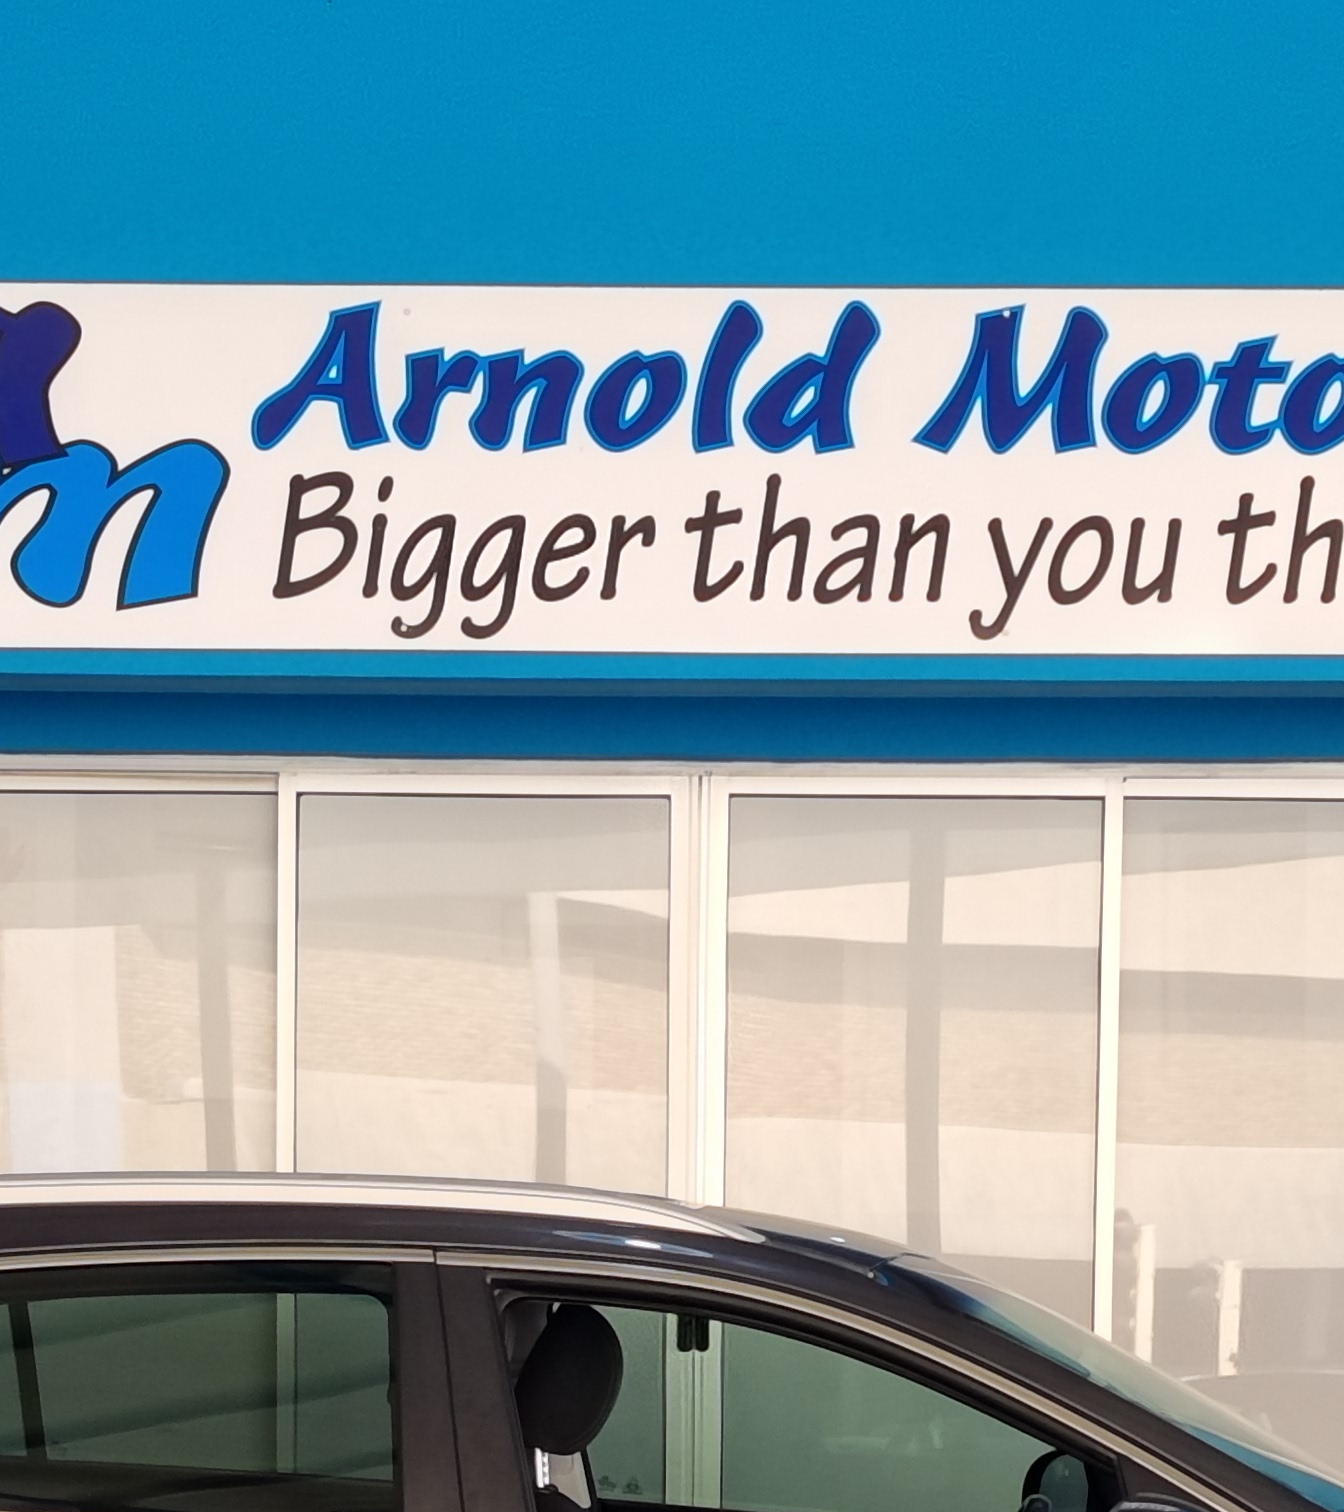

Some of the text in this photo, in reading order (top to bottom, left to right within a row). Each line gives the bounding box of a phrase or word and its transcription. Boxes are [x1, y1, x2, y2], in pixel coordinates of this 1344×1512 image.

[251, 300, 881, 453] Arnold
[273, 471, 654, 639] Bigger
[684, 473, 951, 603] than
[968, 516, 1182, 640] you
